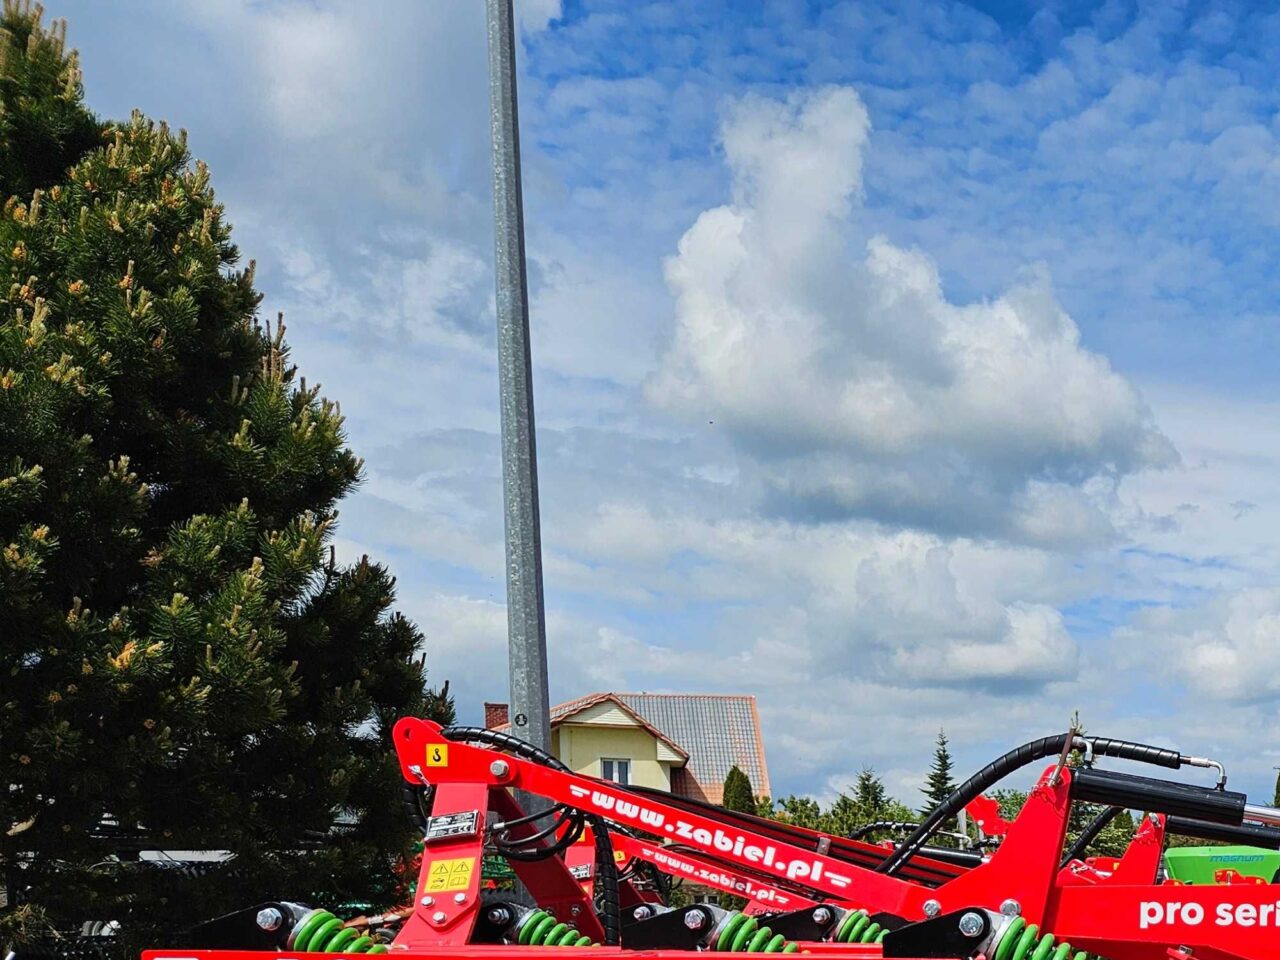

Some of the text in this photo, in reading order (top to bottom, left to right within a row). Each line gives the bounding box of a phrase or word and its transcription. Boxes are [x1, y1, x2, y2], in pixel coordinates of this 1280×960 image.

[591, 790, 823, 882] www.zabiel.pl
[653, 851, 775, 903] www.zabiel.pl
[1210, 855, 1264, 863] magnum
[1139, 901, 1205, 929] pro
